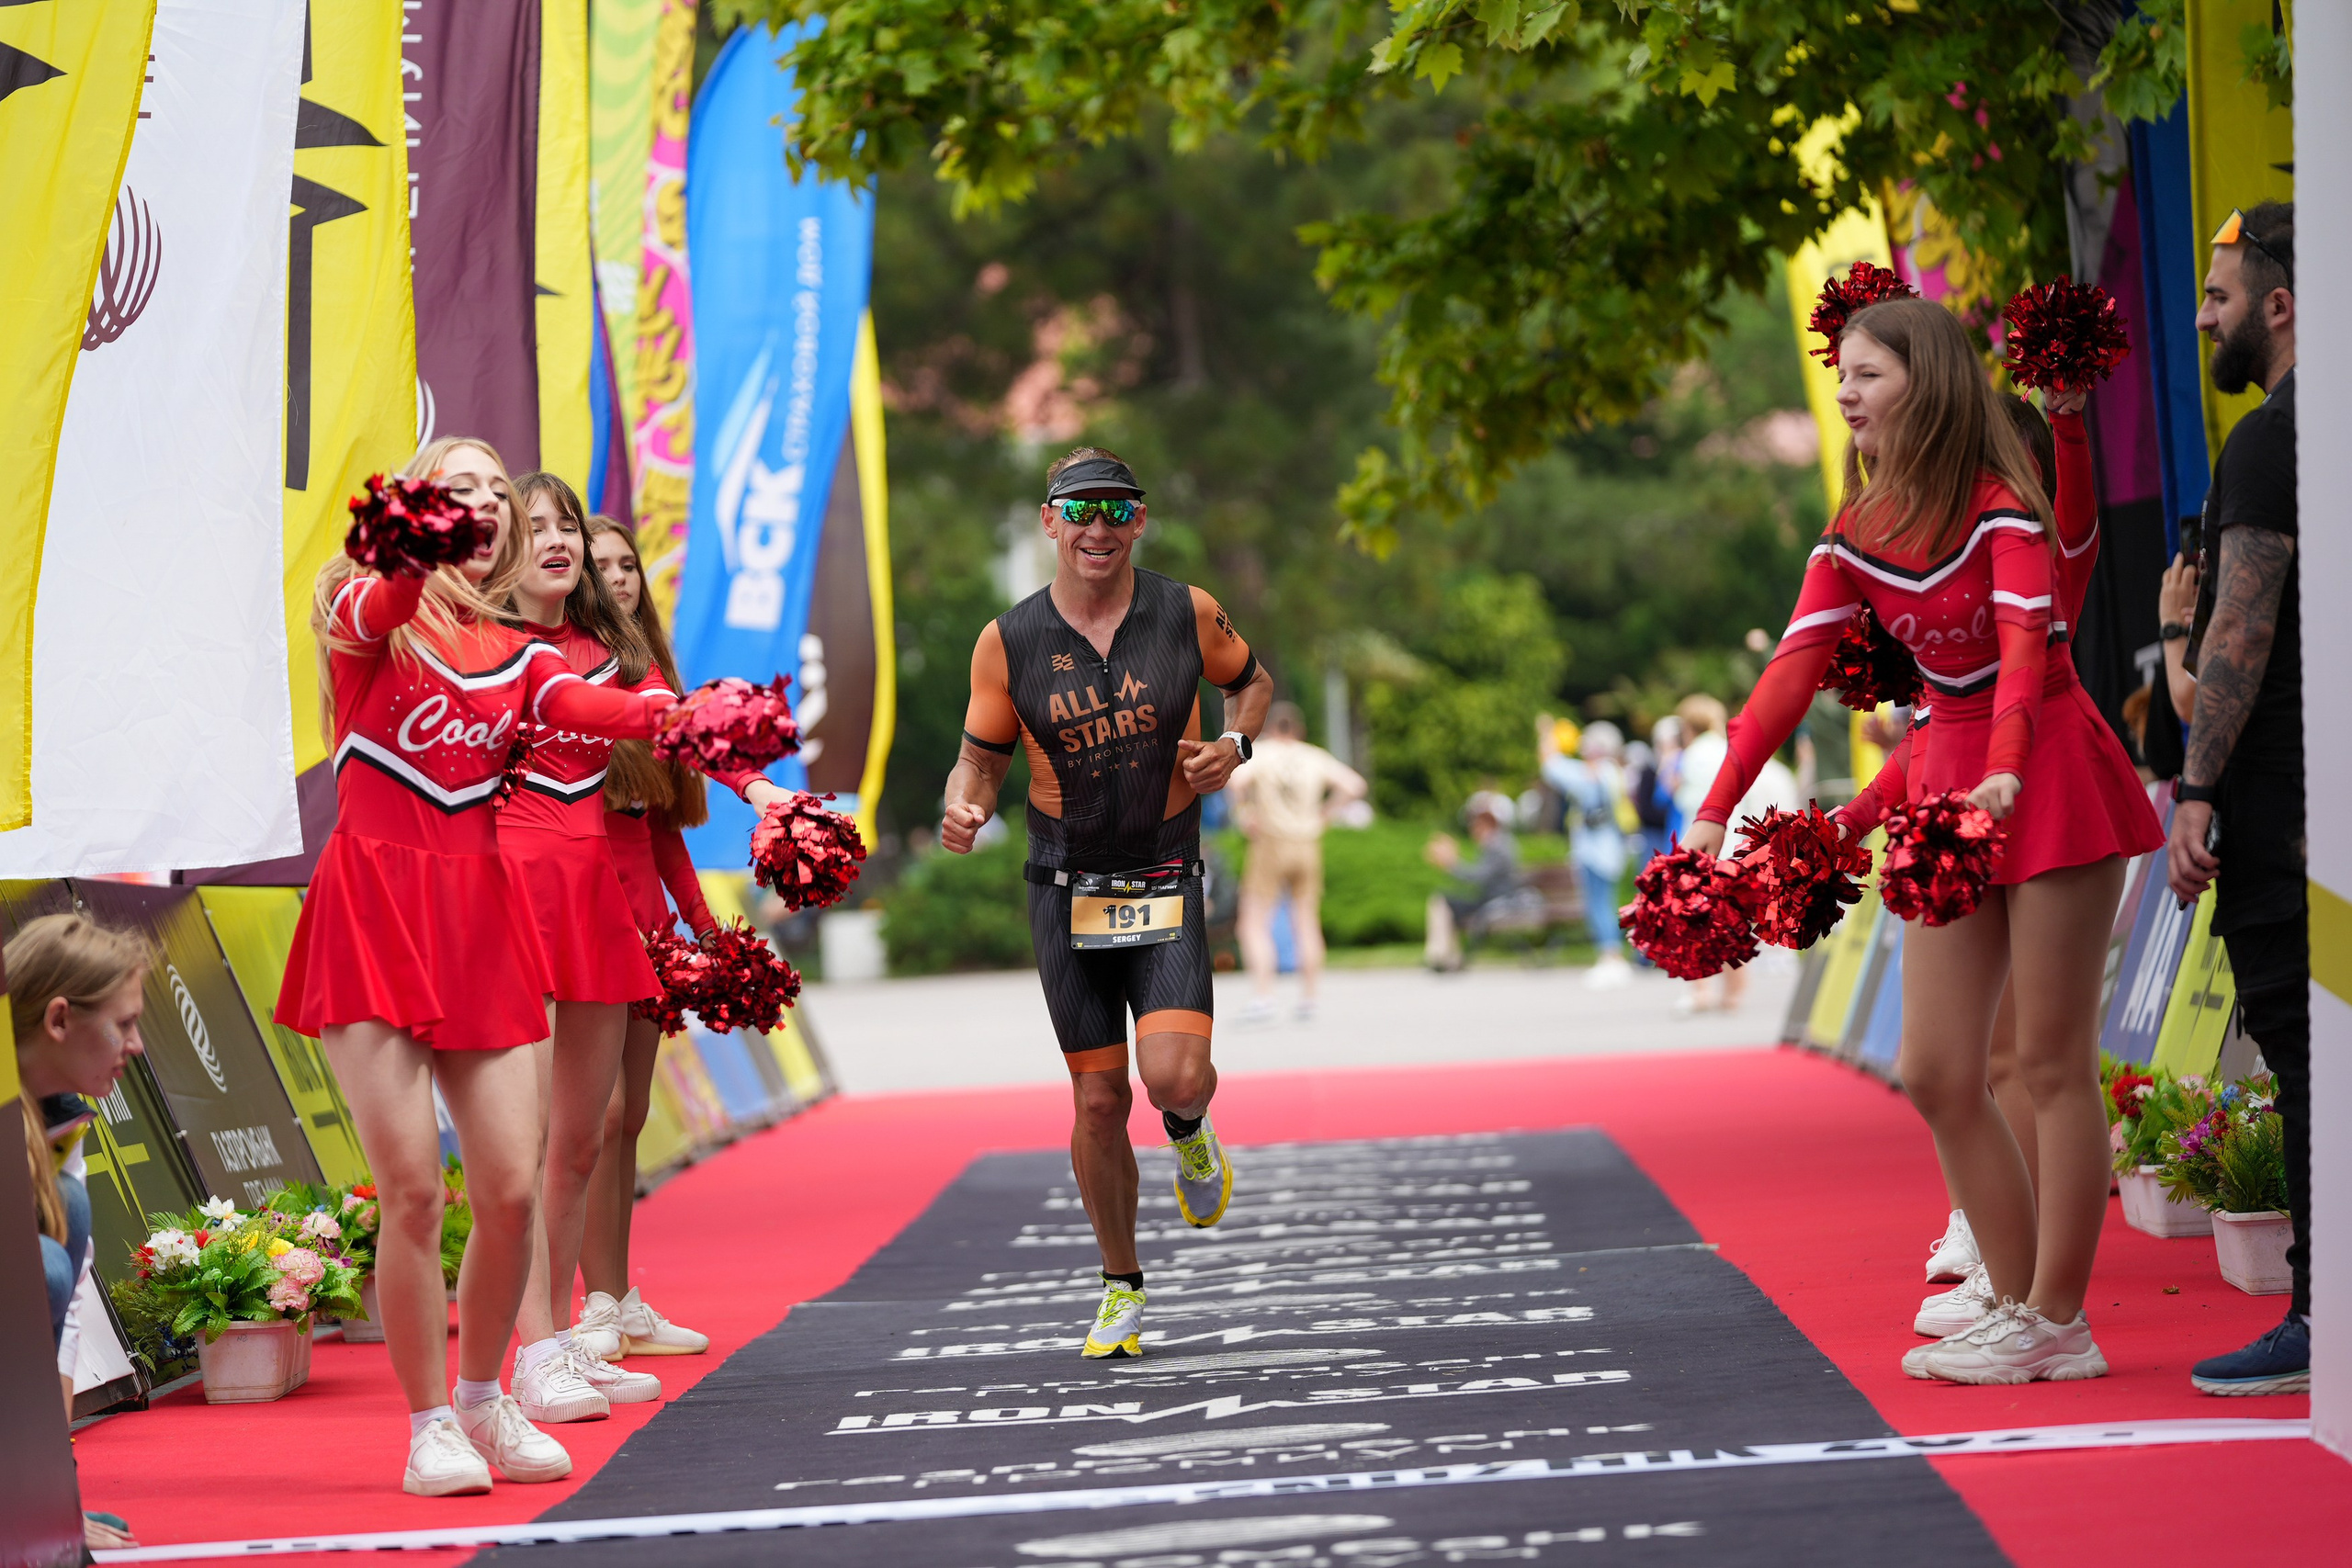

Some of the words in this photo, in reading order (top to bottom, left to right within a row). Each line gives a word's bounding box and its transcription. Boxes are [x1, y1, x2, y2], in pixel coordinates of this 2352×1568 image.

[724, 462, 806, 630] ВСК
[1889, 605, 1996, 652] Cool
[397, 694, 514, 752] Cool
[1049, 685, 1109, 723] ALL
[1058, 704, 1158, 752] STARS
[1068, 758, 1082, 768] BY
[1089, 738, 1158, 762] IRONSTAR
[1111, 879, 1125, 887] IRON
[1131, 880, 1146, 888] STAR
[1103, 904, 1150, 929] 191
[1113, 934, 1141, 943] SERGEY
[1311, 1306, 1594, 1329] STAR
[836, 1402, 1143, 1429] IRON
[1306, 1370, 1631, 1400] STAR
